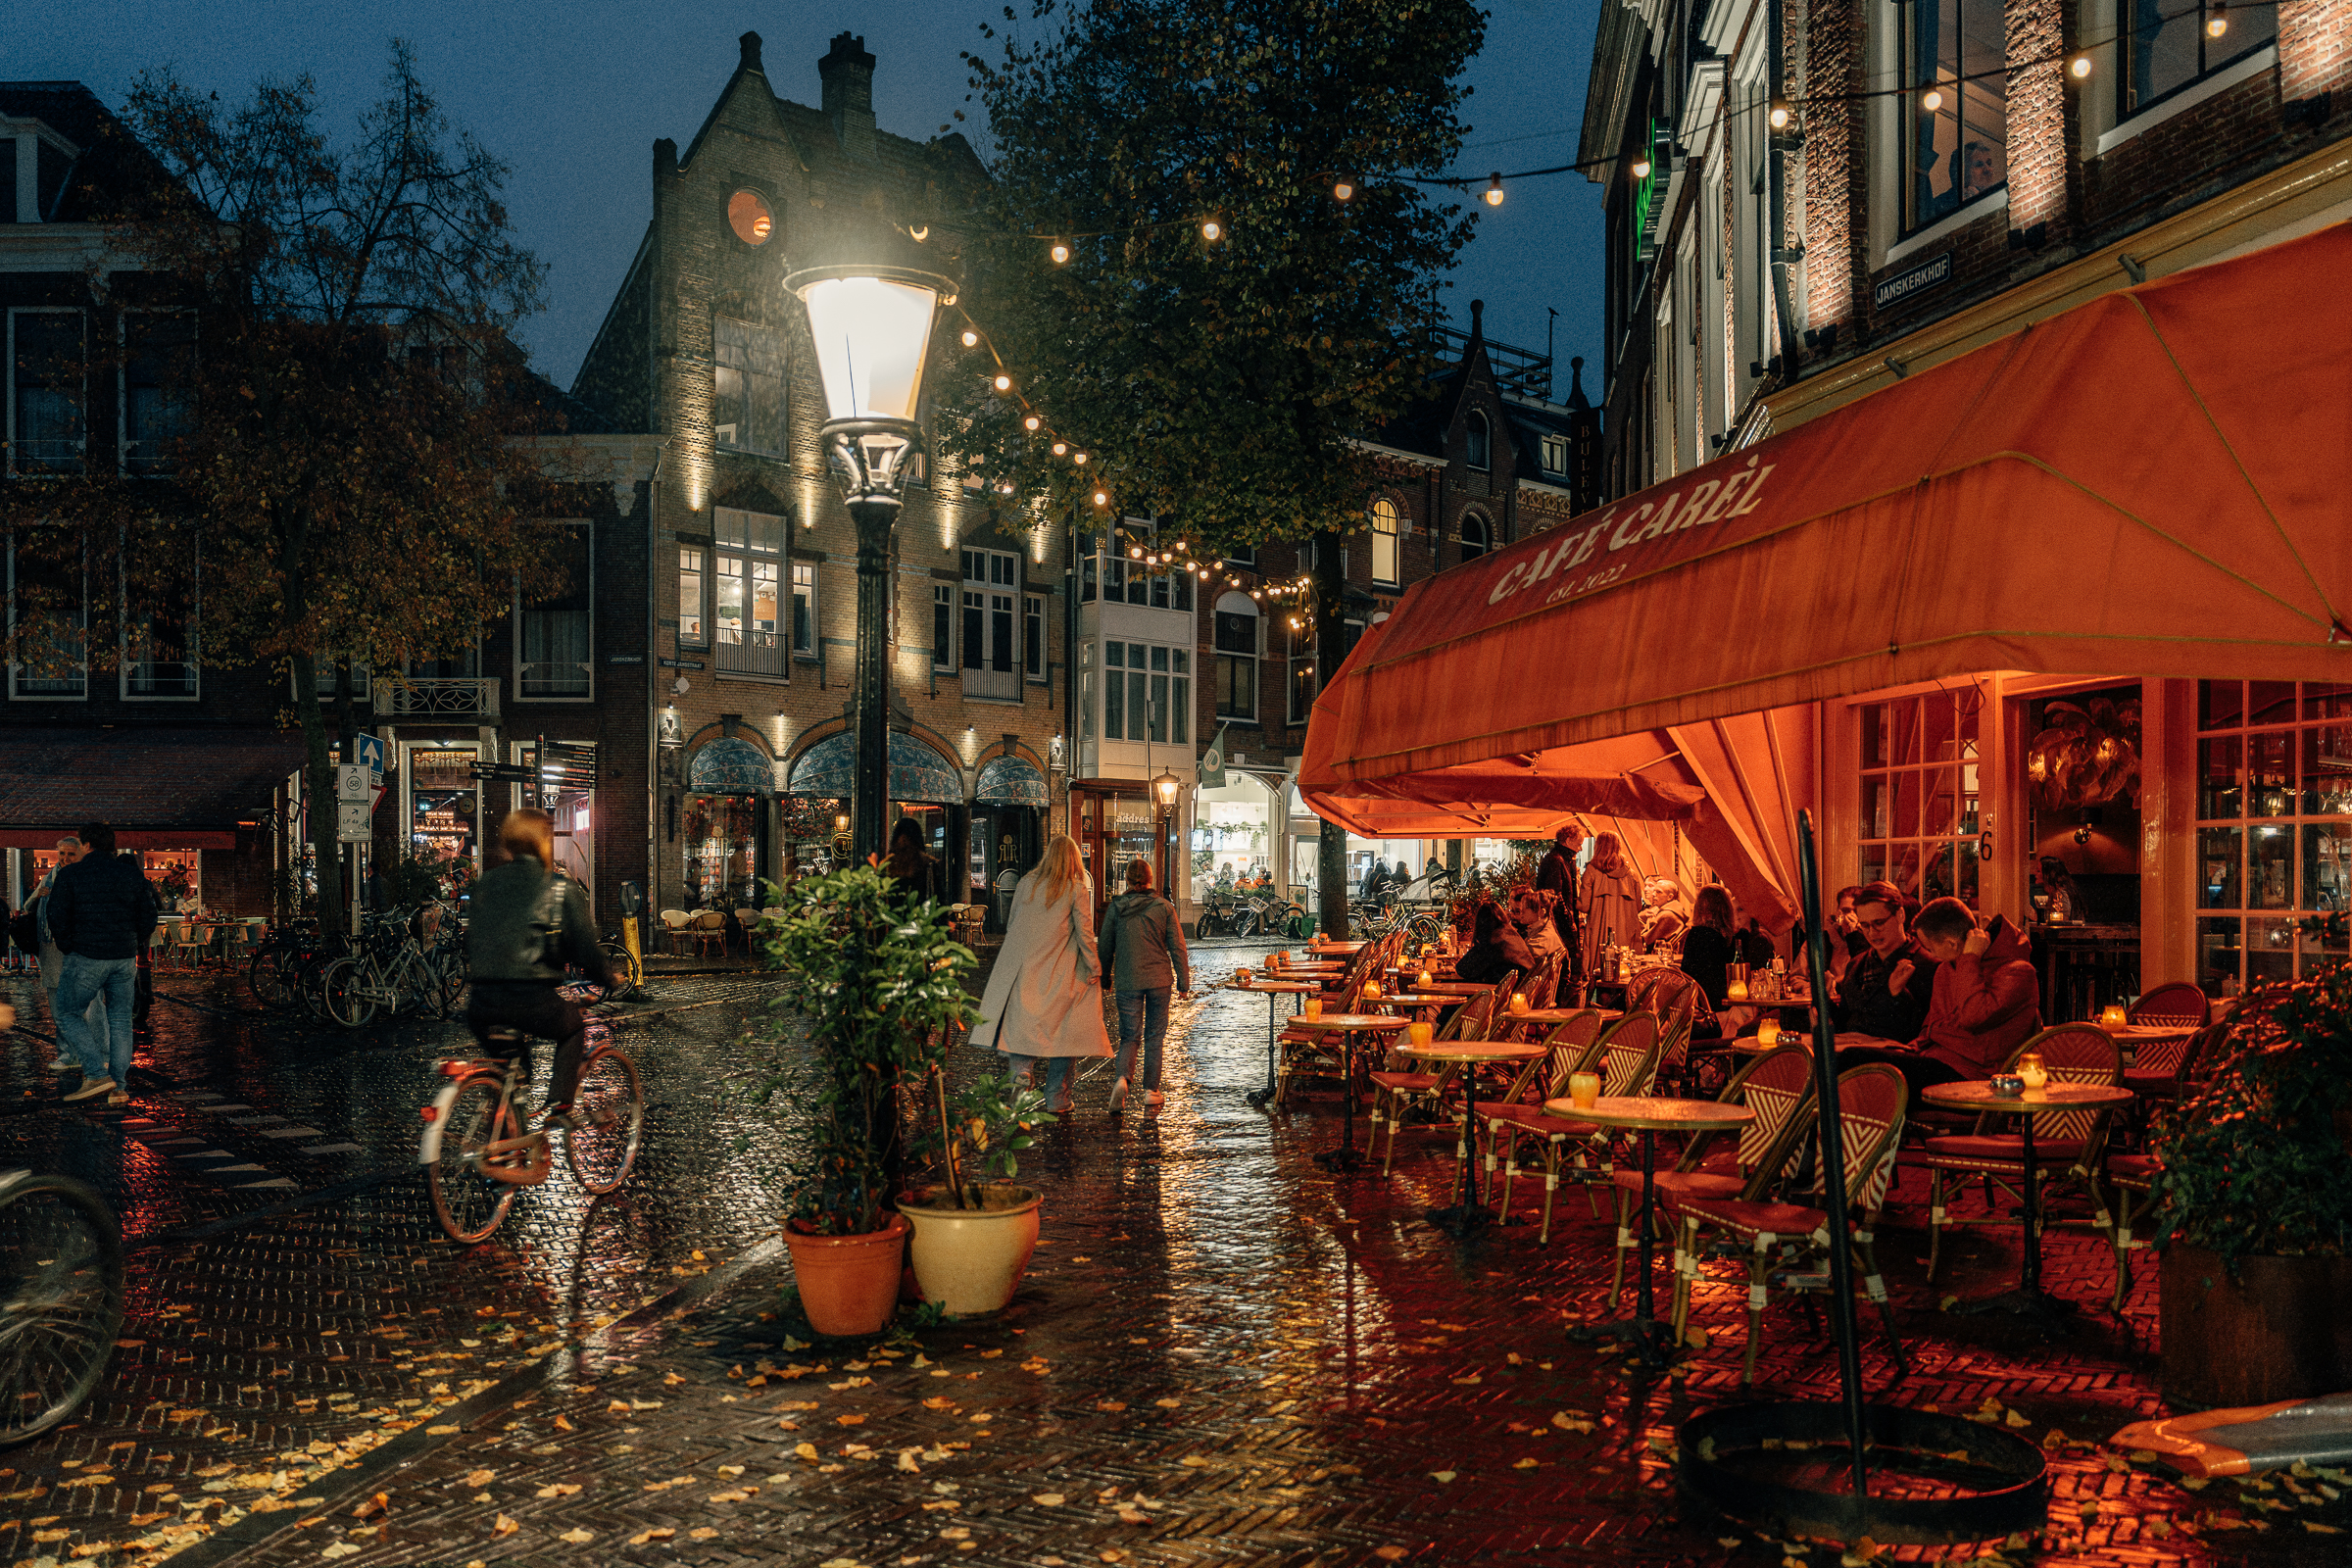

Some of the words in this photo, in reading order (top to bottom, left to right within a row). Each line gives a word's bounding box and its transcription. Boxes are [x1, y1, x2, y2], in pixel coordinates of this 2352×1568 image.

[1877, 258, 1948, 305] JANSKERKHOF
[1488, 506, 1617, 606] CAFÉ
[1576, 563, 1628, 594] 2022
[676, 661, 703, 669] JANSSTRAAT
[1981, 831, 1992, 860] 6
